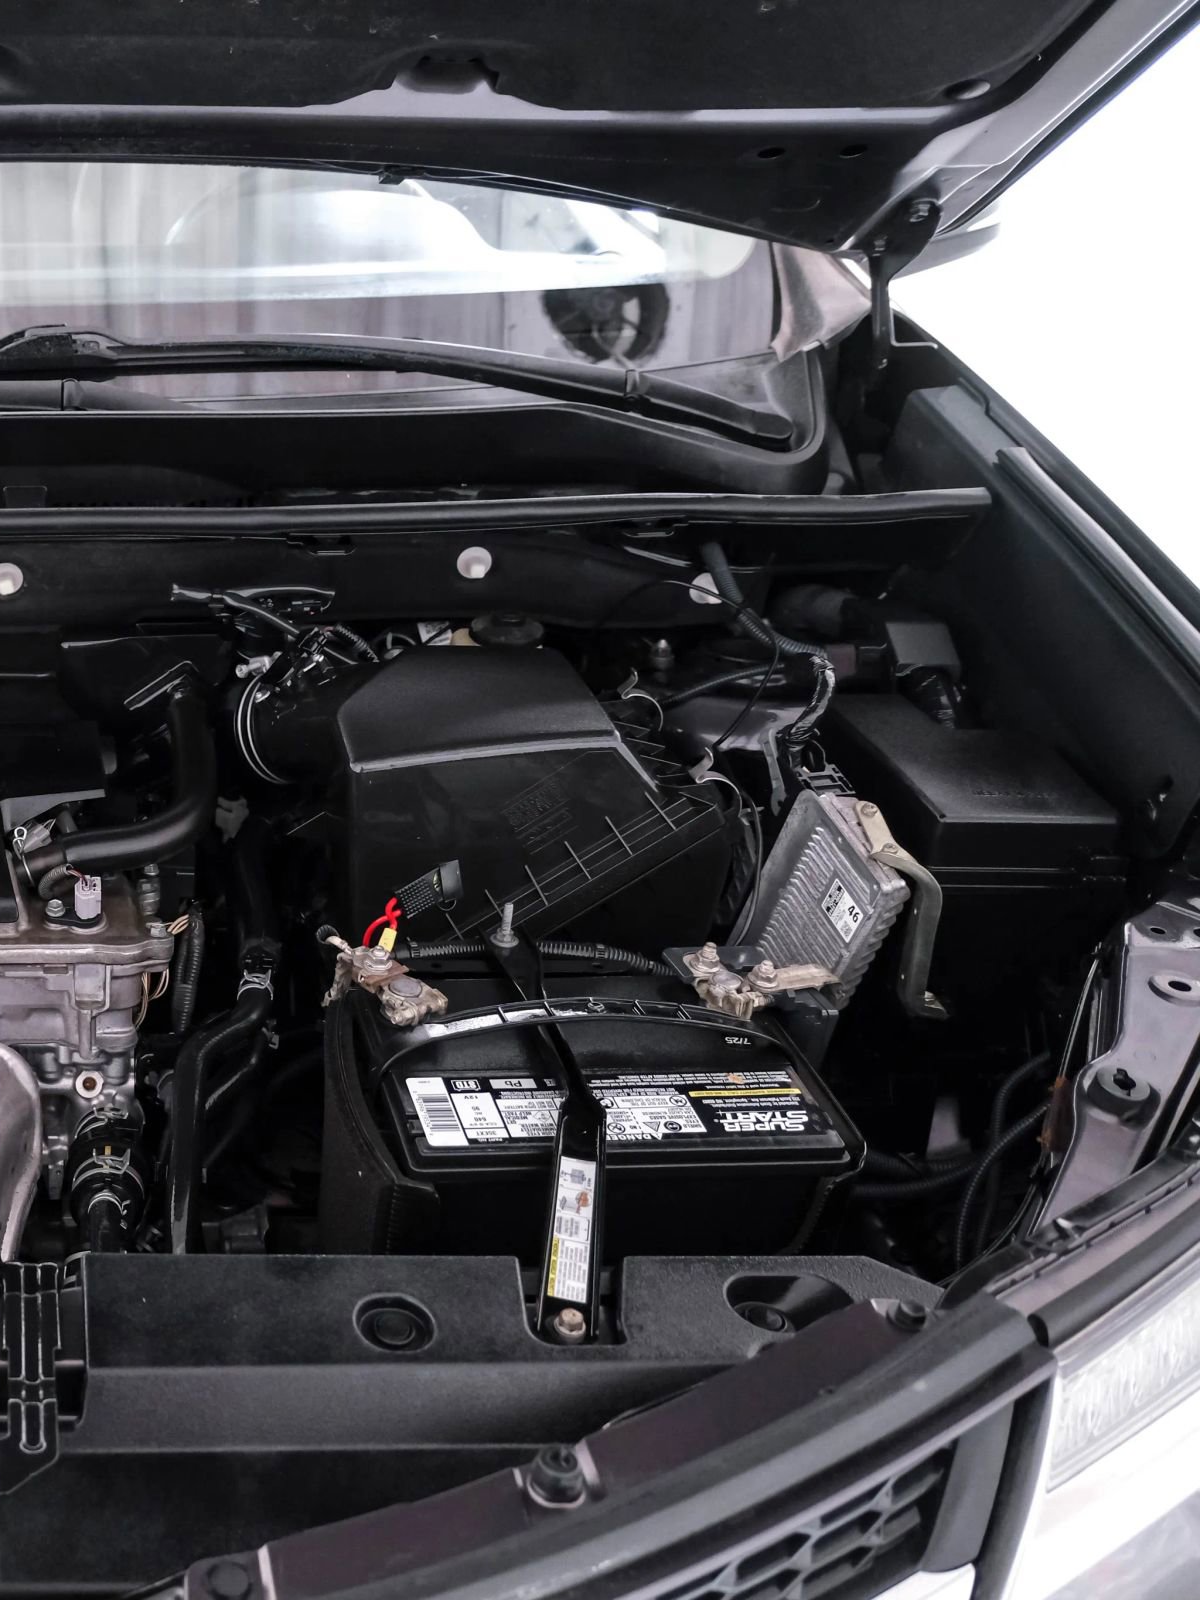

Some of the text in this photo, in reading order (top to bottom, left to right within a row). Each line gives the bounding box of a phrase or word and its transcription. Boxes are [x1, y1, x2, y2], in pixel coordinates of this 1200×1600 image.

[847, 905, 860, 923] 46
[455, 1081, 476, 1089] STD
[504, 1080, 523, 1088] Pb
[719, 1110, 809, 1123] START
[723, 1121, 805, 1132] SUPER
